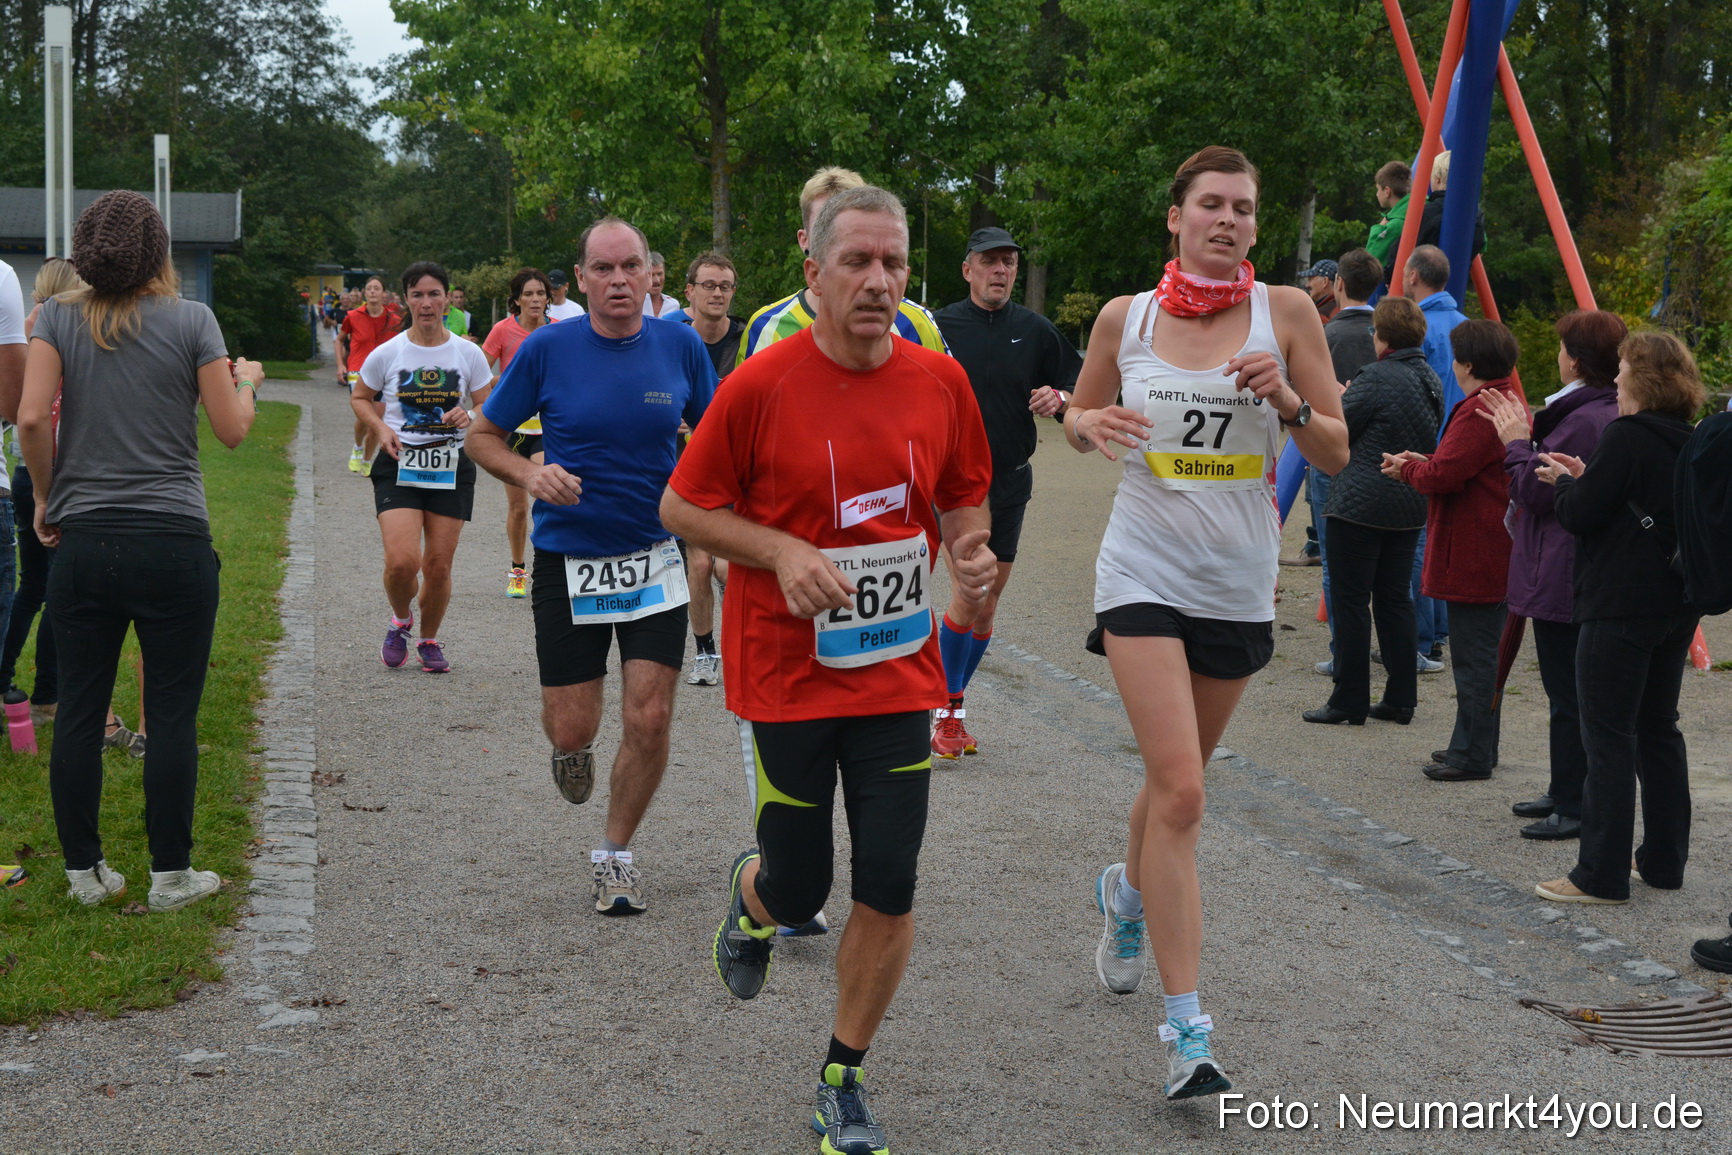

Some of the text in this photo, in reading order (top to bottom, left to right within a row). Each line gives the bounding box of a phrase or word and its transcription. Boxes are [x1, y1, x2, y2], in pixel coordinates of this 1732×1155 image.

[1148, 389, 1249, 407] PARTL Neumarkt
[1182, 409, 1233, 450] 27
[405, 448, 451, 469] 2061
[1174, 458, 1234, 476] Sabrina
[418, 472, 437, 481] Irene
[858, 495, 888, 515] DEHN
[861, 550, 917, 569] Neumarkt
[577, 555, 651, 594] 2457
[596, 593, 642, 611] Richard
[859, 627, 900, 649] Peter
